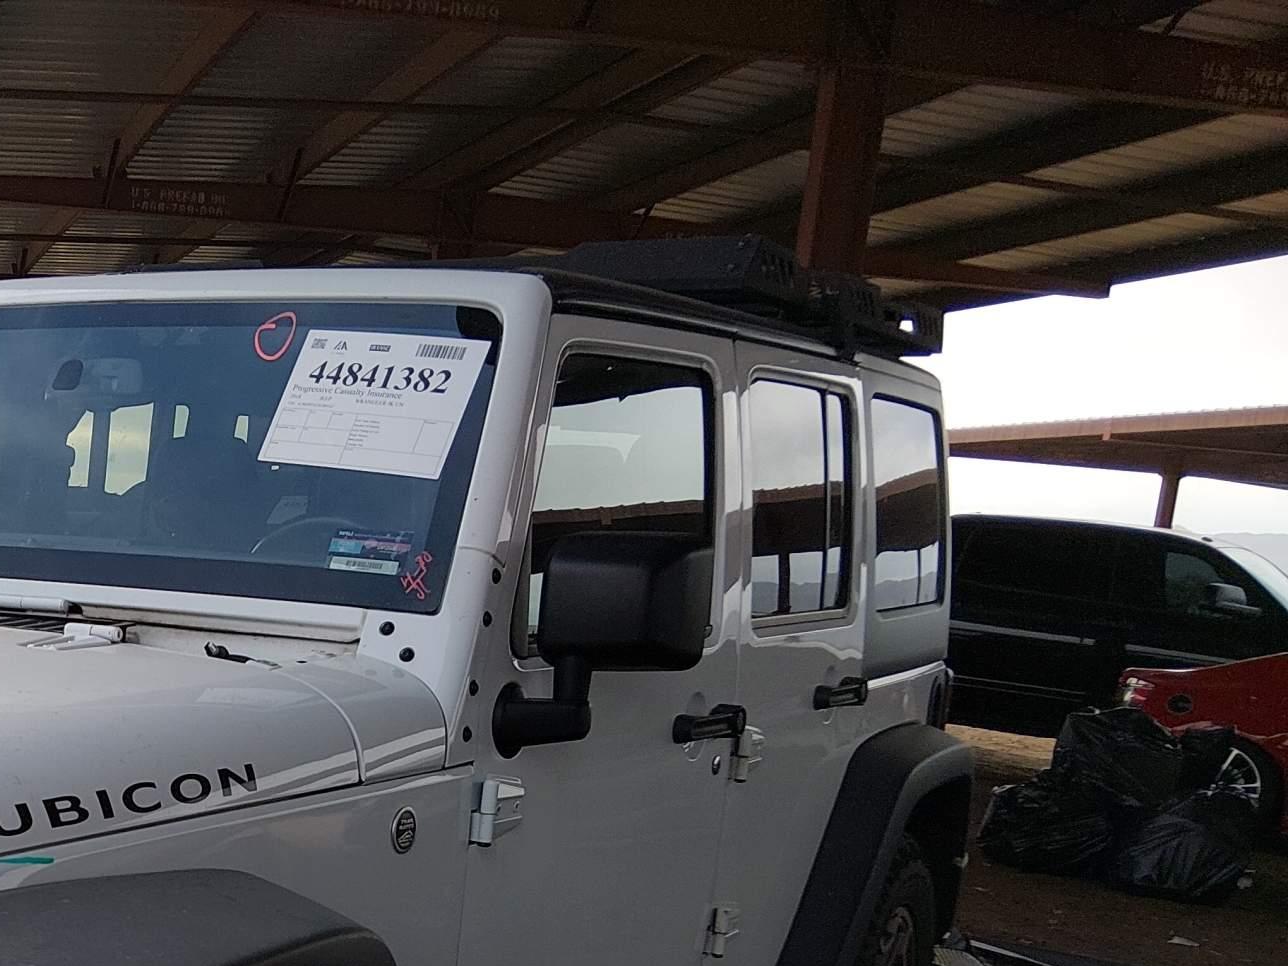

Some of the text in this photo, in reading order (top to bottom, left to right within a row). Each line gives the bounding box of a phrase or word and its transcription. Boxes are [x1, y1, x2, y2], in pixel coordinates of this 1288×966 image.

[309, 361, 452, 394] 44841382
[293, 384, 403, 401] Progressive Casualty Insurance
